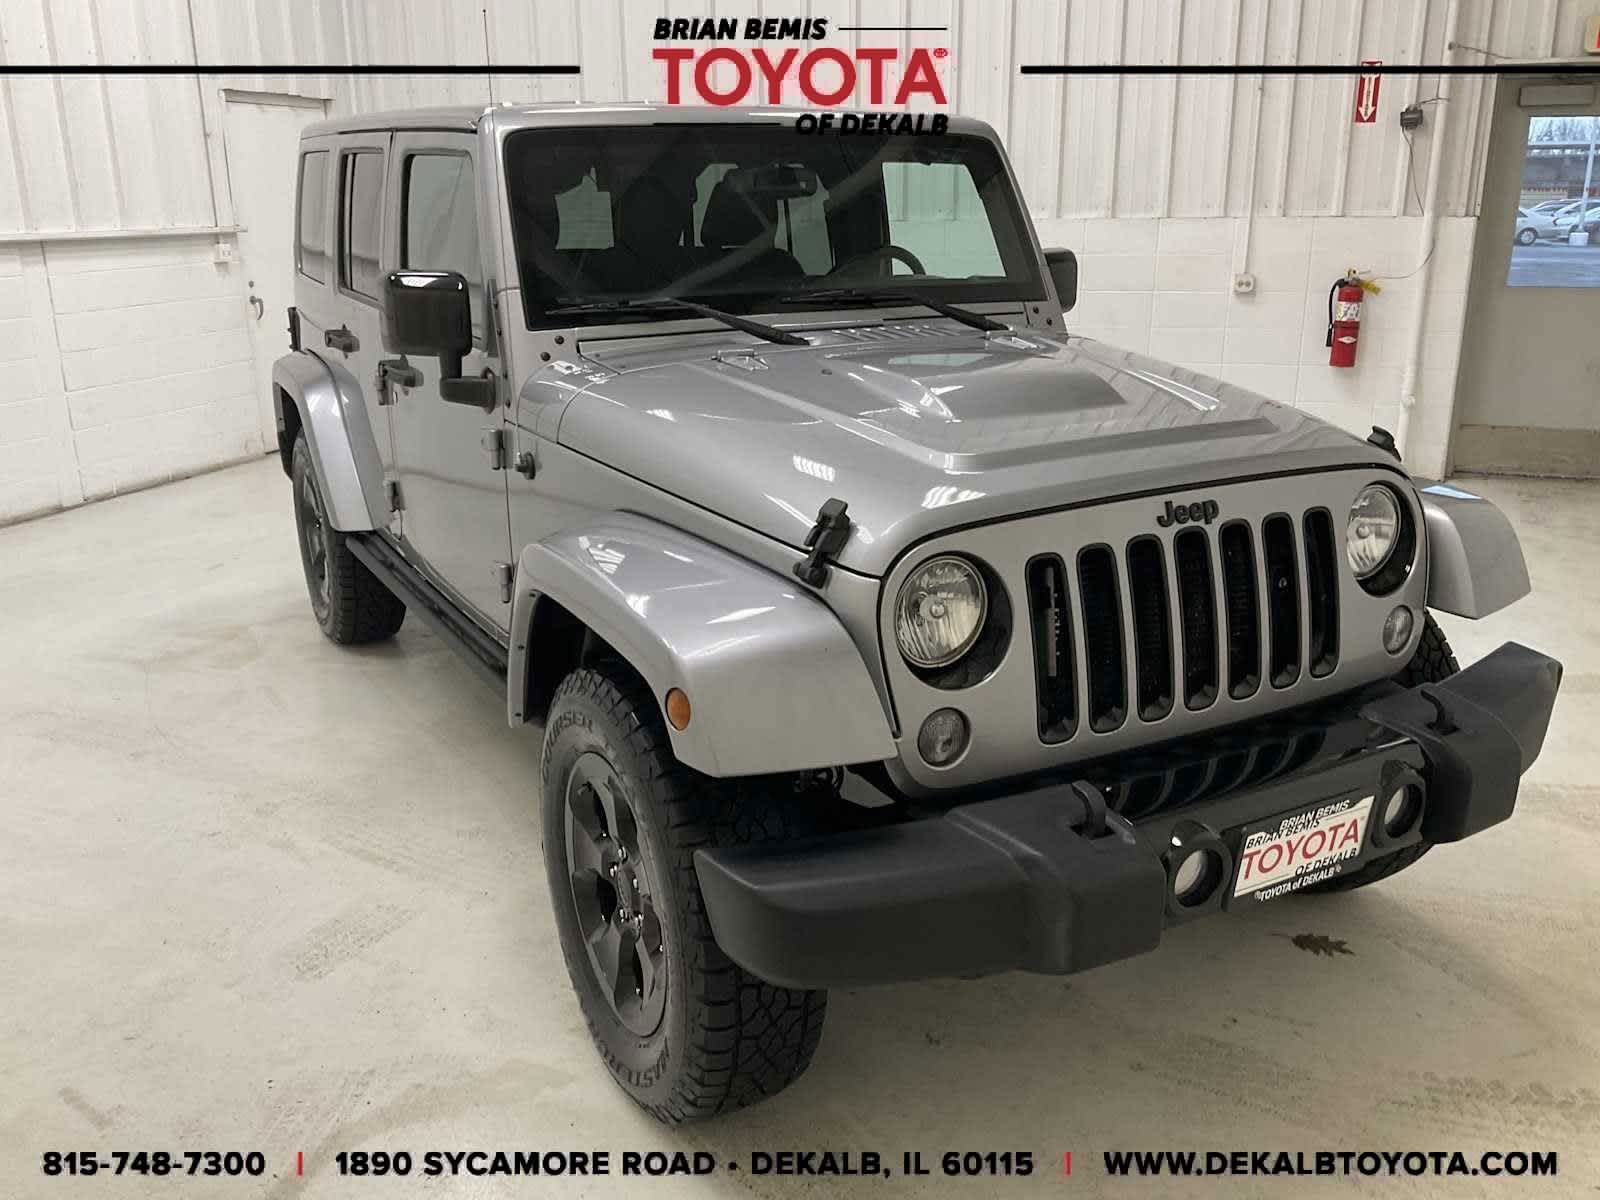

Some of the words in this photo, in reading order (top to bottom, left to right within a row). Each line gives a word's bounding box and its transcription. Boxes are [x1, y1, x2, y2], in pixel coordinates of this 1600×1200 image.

[1156, 499, 1219, 528] Jeep
[1280, 811, 1315, 831] BRIAN
[1315, 799, 1350, 819] BEMIS
[1284, 818, 1320, 838] BEMIS
[1242, 818, 1359, 880] TOYOTA
[1260, 884, 1292, 902] TOYOTA
[1292, 879, 1302, 891] of
[1302, 867, 1335, 887] DEKALB
